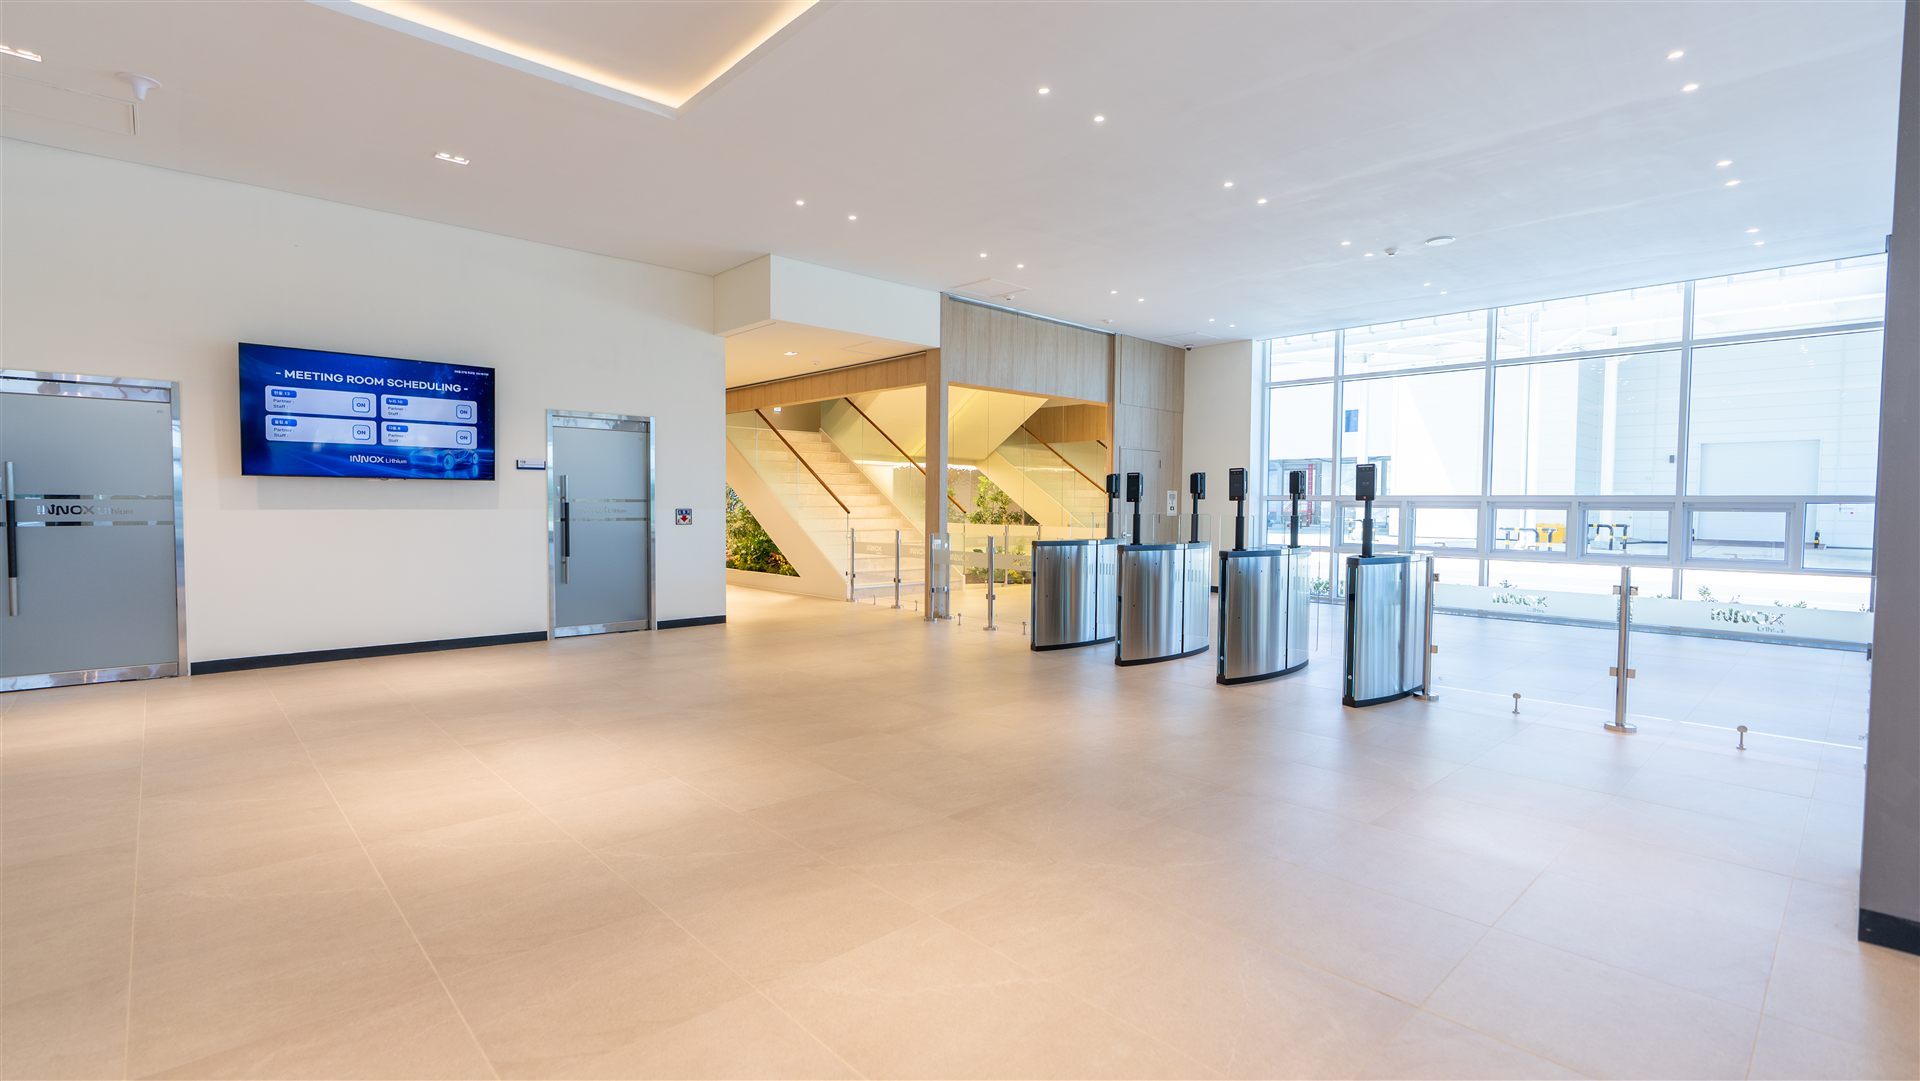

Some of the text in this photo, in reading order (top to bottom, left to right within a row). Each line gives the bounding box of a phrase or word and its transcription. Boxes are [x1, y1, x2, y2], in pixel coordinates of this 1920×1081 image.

[284, 369, 344, 383] MEETING
[347, 375, 384, 386] ROOM
[387, 378, 462, 393] SCHEDULING
[350, 454, 385, 464] INNOX
[36, 504, 95, 516] INNOX
[1711, 607, 1785, 625] INNOX
